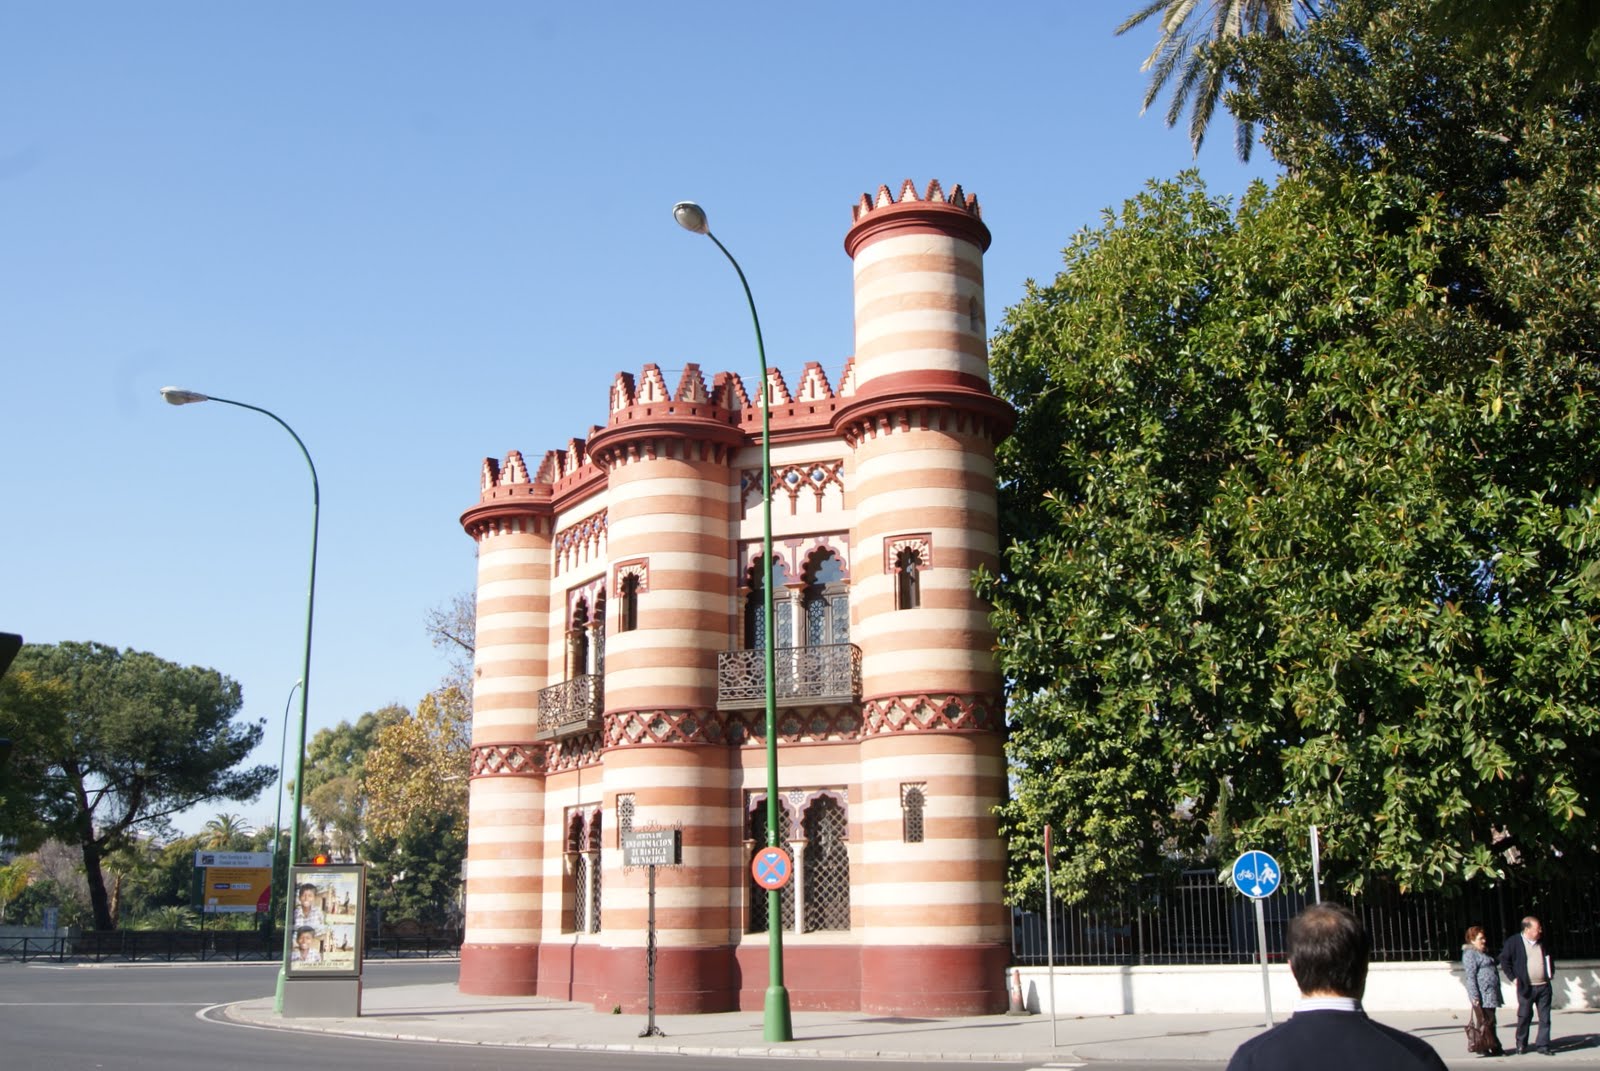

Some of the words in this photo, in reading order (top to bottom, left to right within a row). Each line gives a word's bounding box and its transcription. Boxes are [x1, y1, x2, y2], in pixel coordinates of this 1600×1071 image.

[625, 839, 672, 848] INFORMACION
[632, 848, 666, 856] TURISTICA
[631, 856, 666, 864] MUNICIPAL
